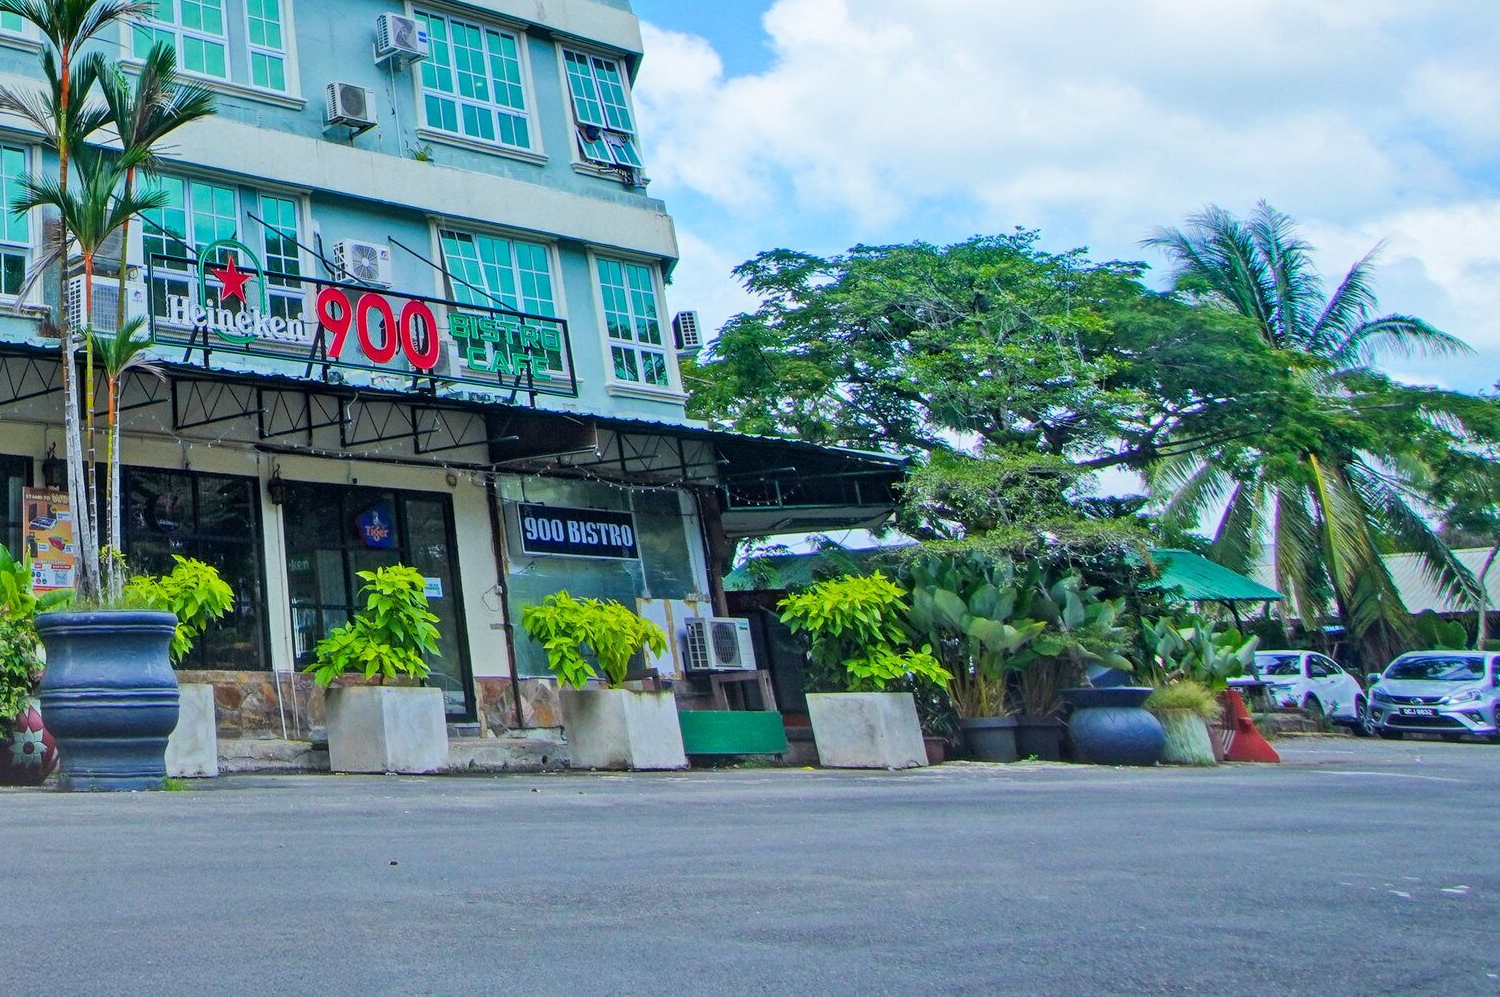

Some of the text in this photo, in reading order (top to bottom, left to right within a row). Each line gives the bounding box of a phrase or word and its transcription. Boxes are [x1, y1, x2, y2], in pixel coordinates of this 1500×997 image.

[168, 294, 307, 342] Heineken
[315, 287, 440, 370] 900
[448, 312, 561, 352] BISTRO
[466, 346, 552, 381] CAFE
[364, 525, 389, 542] Tiger
[524, 517, 633, 547] 900 BISTRO
